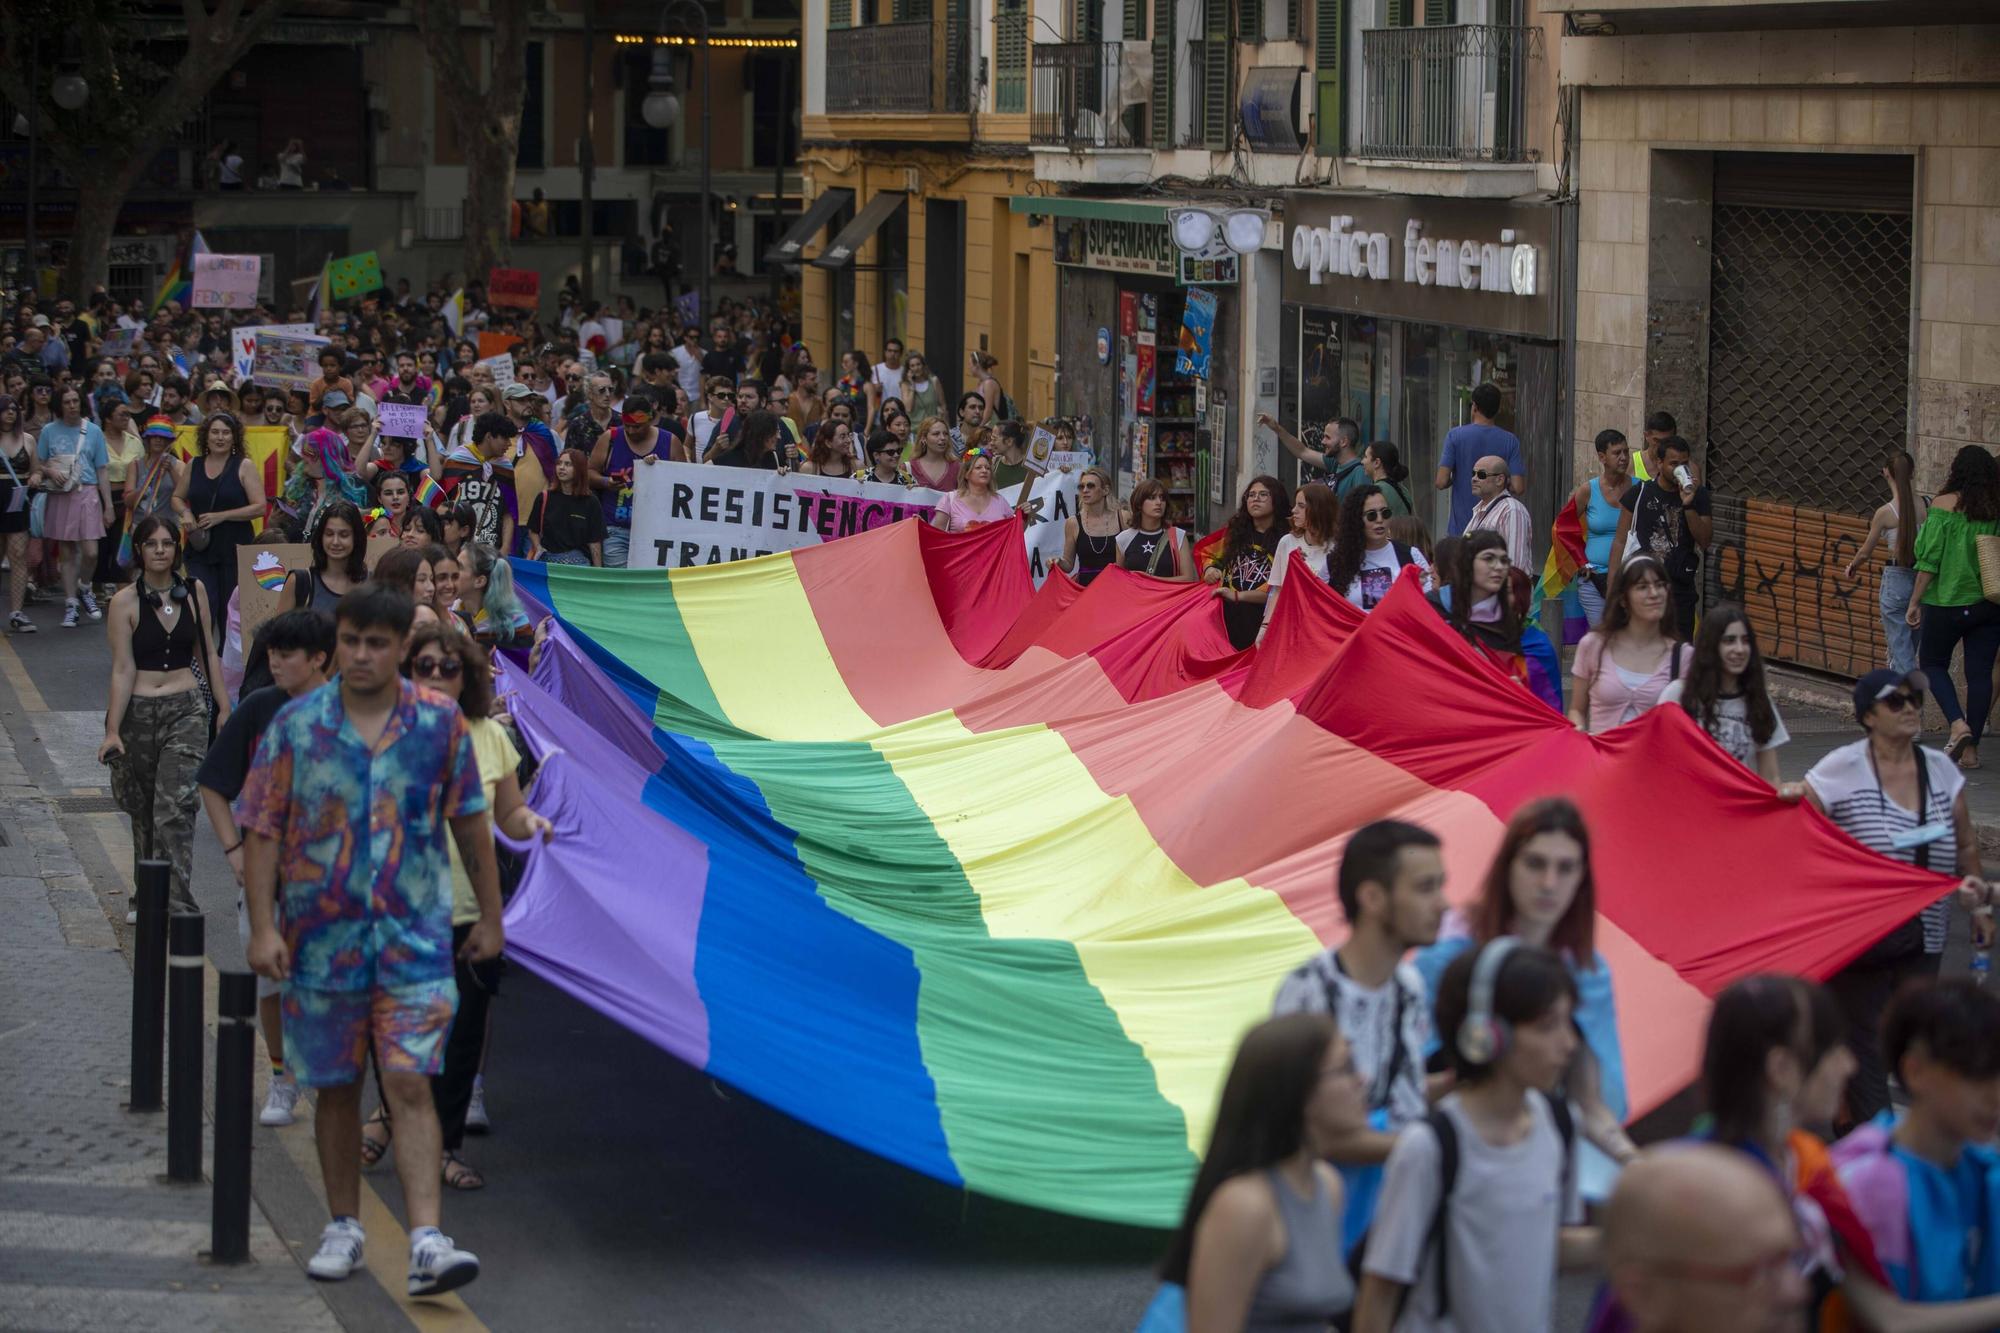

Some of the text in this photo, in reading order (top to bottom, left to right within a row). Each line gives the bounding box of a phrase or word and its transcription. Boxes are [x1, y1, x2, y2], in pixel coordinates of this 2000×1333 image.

[1292, 215, 1538, 296] optica femenia
[654, 539, 772, 568] TRAN
